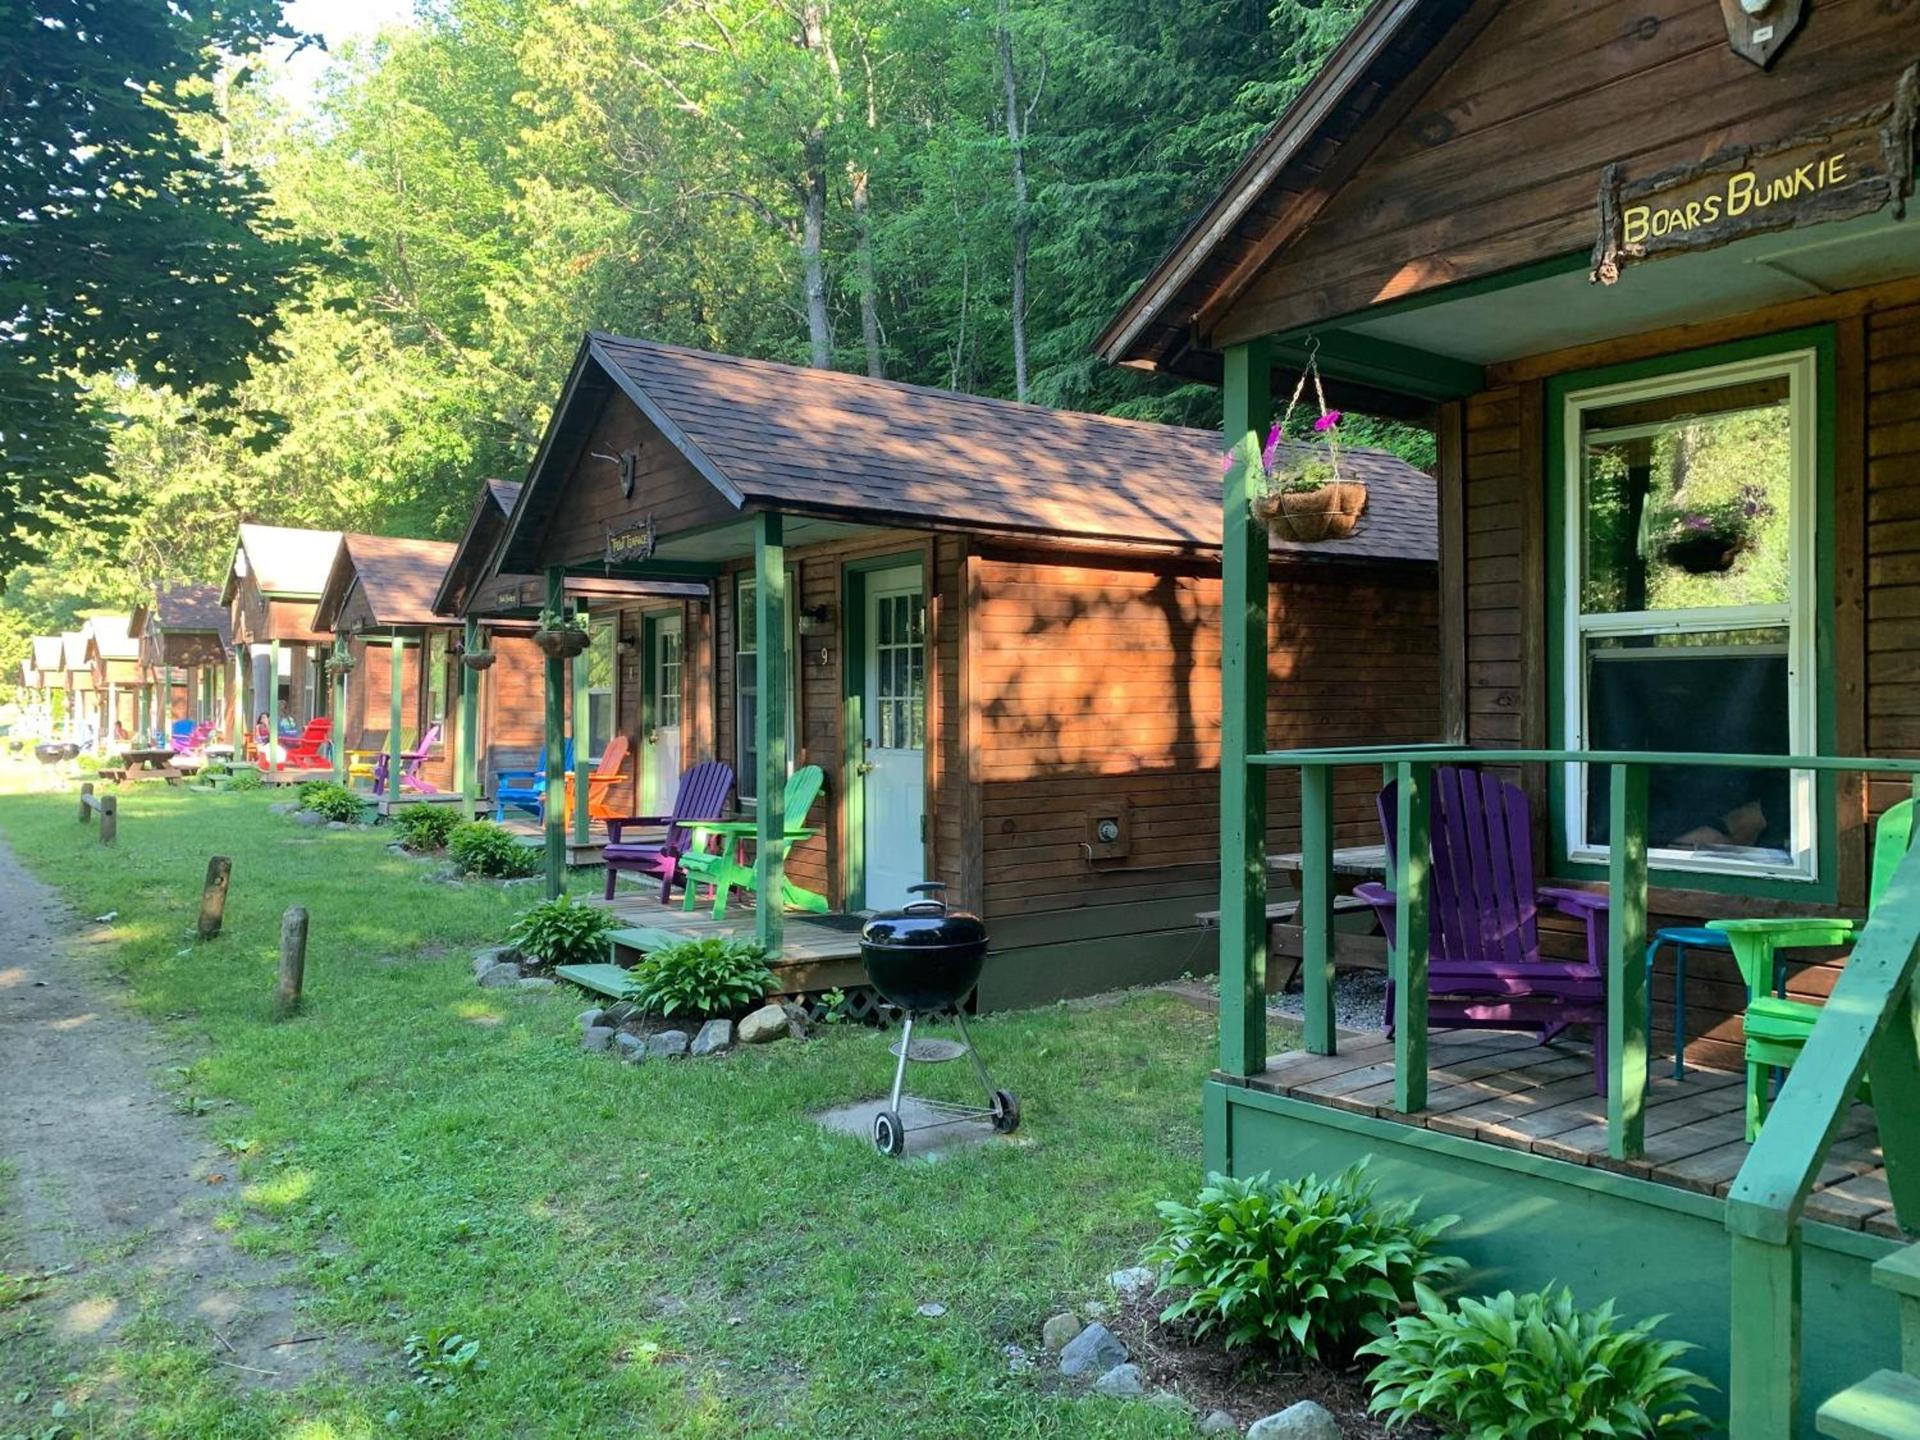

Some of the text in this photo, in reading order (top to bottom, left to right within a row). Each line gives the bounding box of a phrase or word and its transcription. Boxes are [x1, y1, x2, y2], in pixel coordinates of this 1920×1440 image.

[1623, 153, 1848, 244] BOARS BUNKIE
[821, 647, 828, 665] 9
